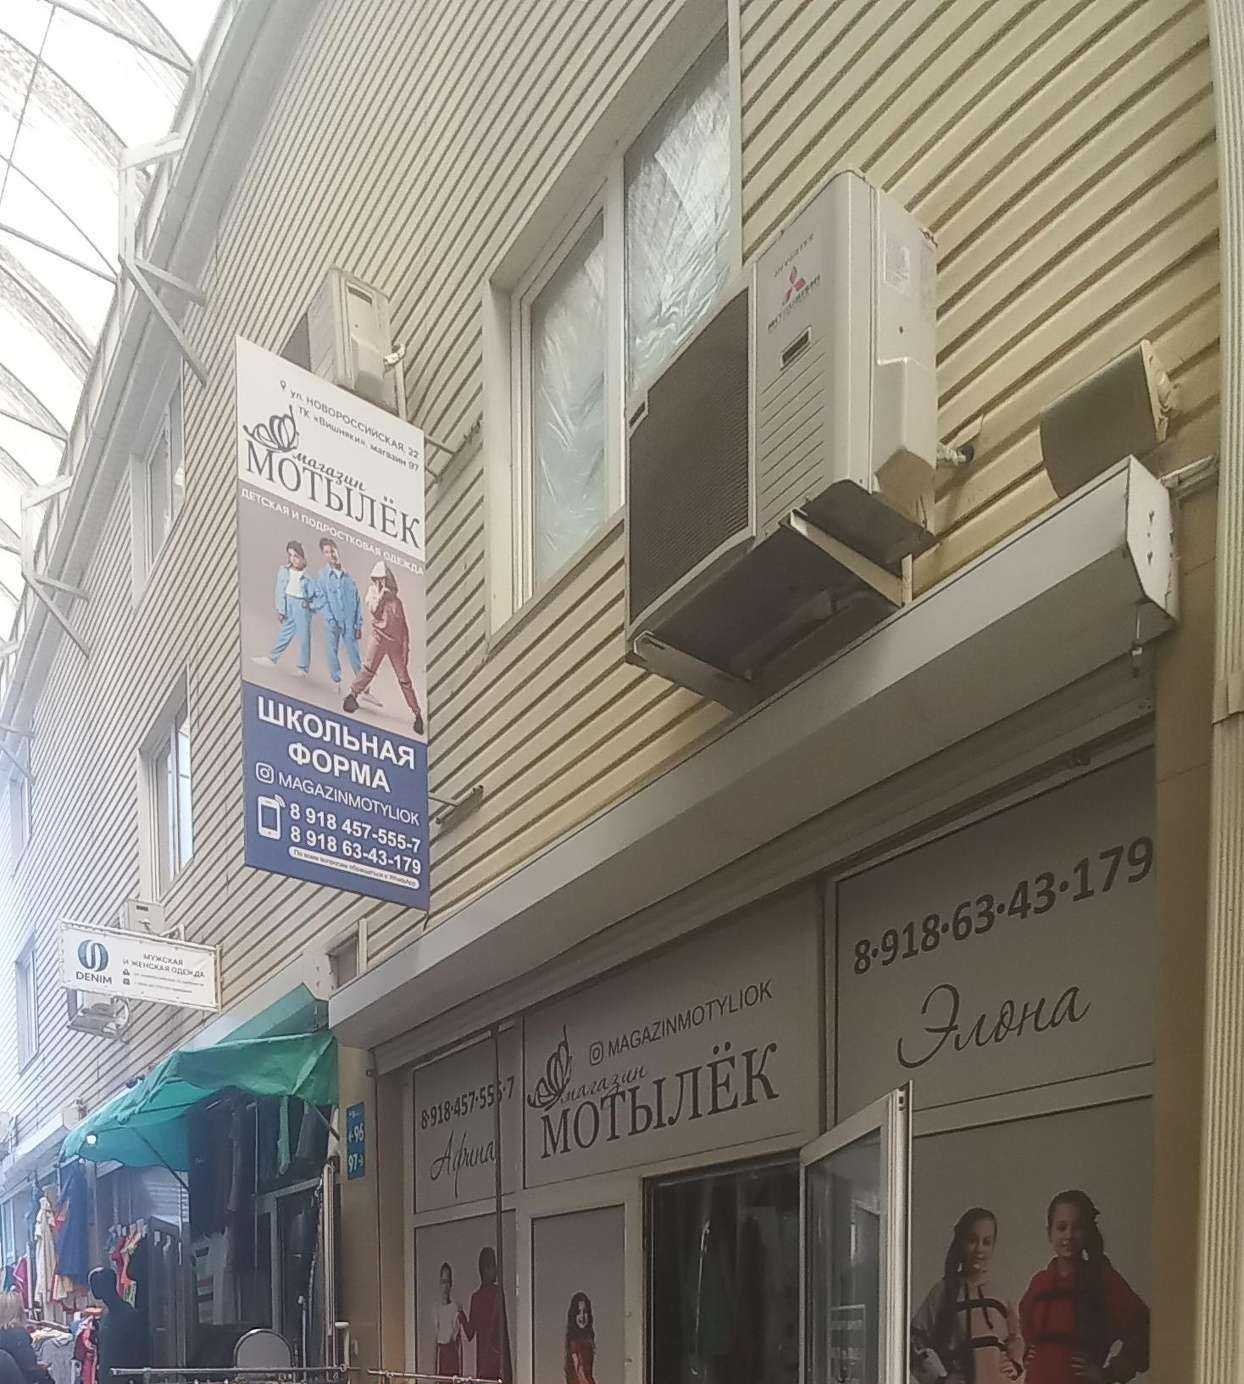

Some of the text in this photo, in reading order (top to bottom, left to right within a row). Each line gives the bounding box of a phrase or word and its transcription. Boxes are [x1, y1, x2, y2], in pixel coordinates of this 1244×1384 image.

[247, 439, 421, 549] МОТЫЛЁК
[292, 452, 367, 492] магазин
[241, 488, 290, 518] ДЕТСКАЯ
[291, 509, 299, 520] И
[301, 515, 381, 557] ПОДРОСТКОВАЯ
[257, 695, 416, 770] ШКОЛЬНАЯ
[288, 742, 391, 793] ФОРМА
[278, 771, 421, 827] MAGAZINMOTYLIOK
[290, 803, 421, 853] 8 918 457-555-7
[290, 826, 301, 843] 8
[306, 831, 337, 852] 918
[342, 839, 421, 875] 63-43-179
[75, 971, 113, 985] DENIM
[131, 960, 170, 971] ЖЕНСКАЯ
[144, 952, 183, 966] МУЖСКАЯ
[607, 979, 773, 1057] MAGAZINMOTYLIOK
[897, 983, 1092, 1069] Элона
[540, 1041, 780, 1159] МОТЫЛЁК
[560, 1065, 648, 1101] магазин
